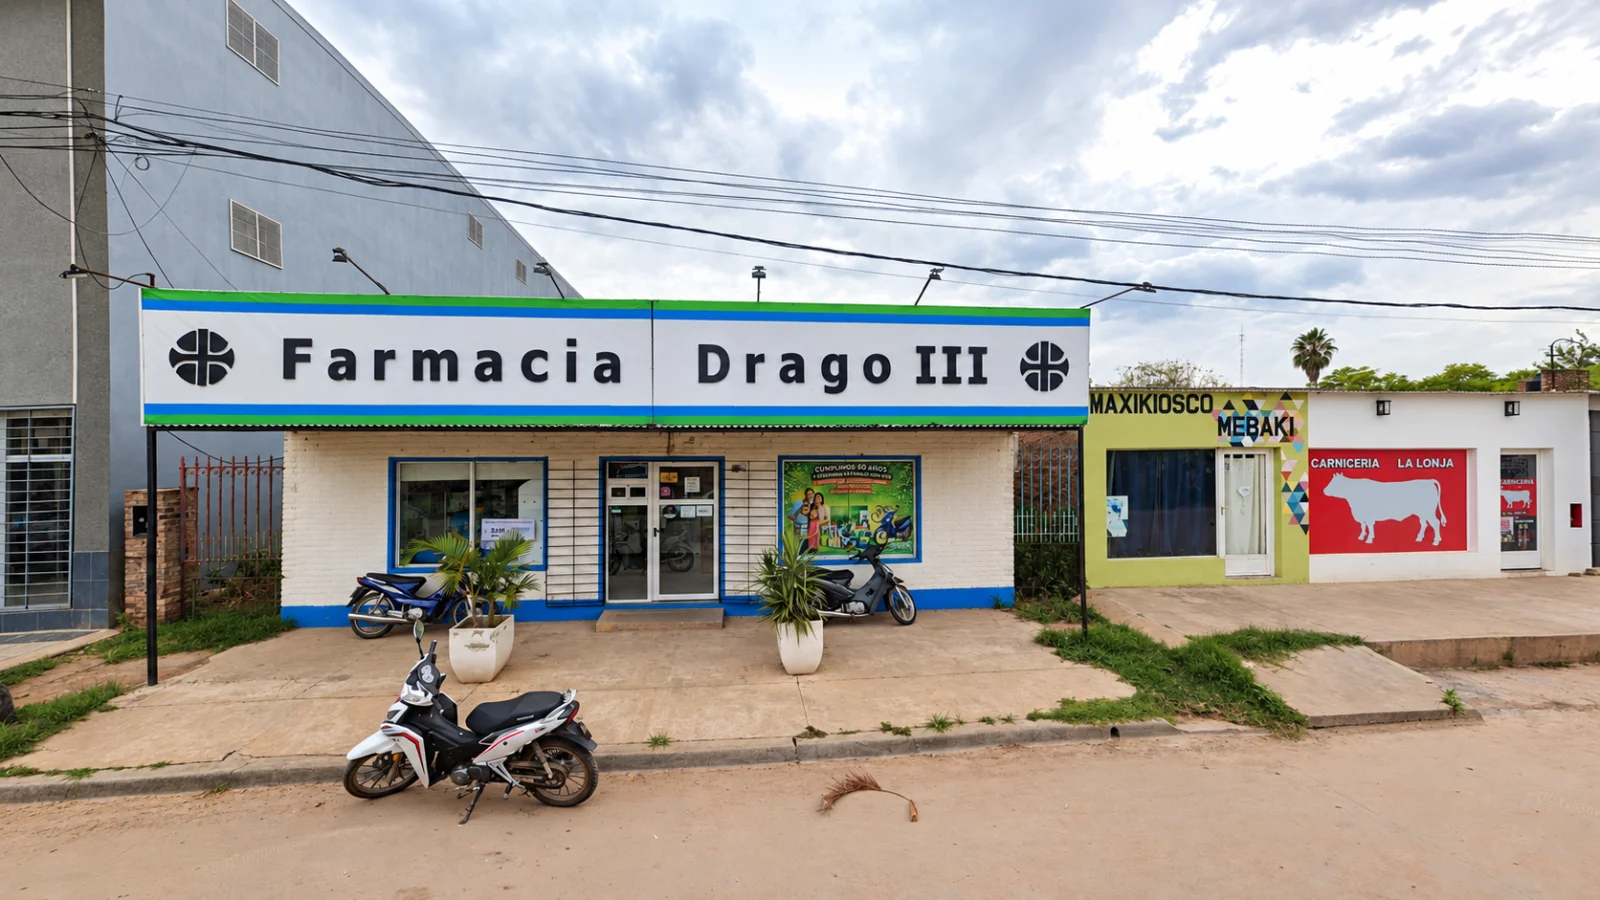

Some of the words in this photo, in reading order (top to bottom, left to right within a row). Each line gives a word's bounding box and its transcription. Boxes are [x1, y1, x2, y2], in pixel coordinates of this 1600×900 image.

[282, 337, 622, 384] Farmacia
[698, 343, 892, 395] Drago
[915, 345, 988, 386] III
[1089, 392, 1214, 415] MAXIKIOSCO
[1217, 415, 1295, 437] MEBAKI
[1310, 458, 1380, 469] CARNICERIA
[1397, 458, 1413, 469] LA
[1416, 458, 1454, 469] LONJA
